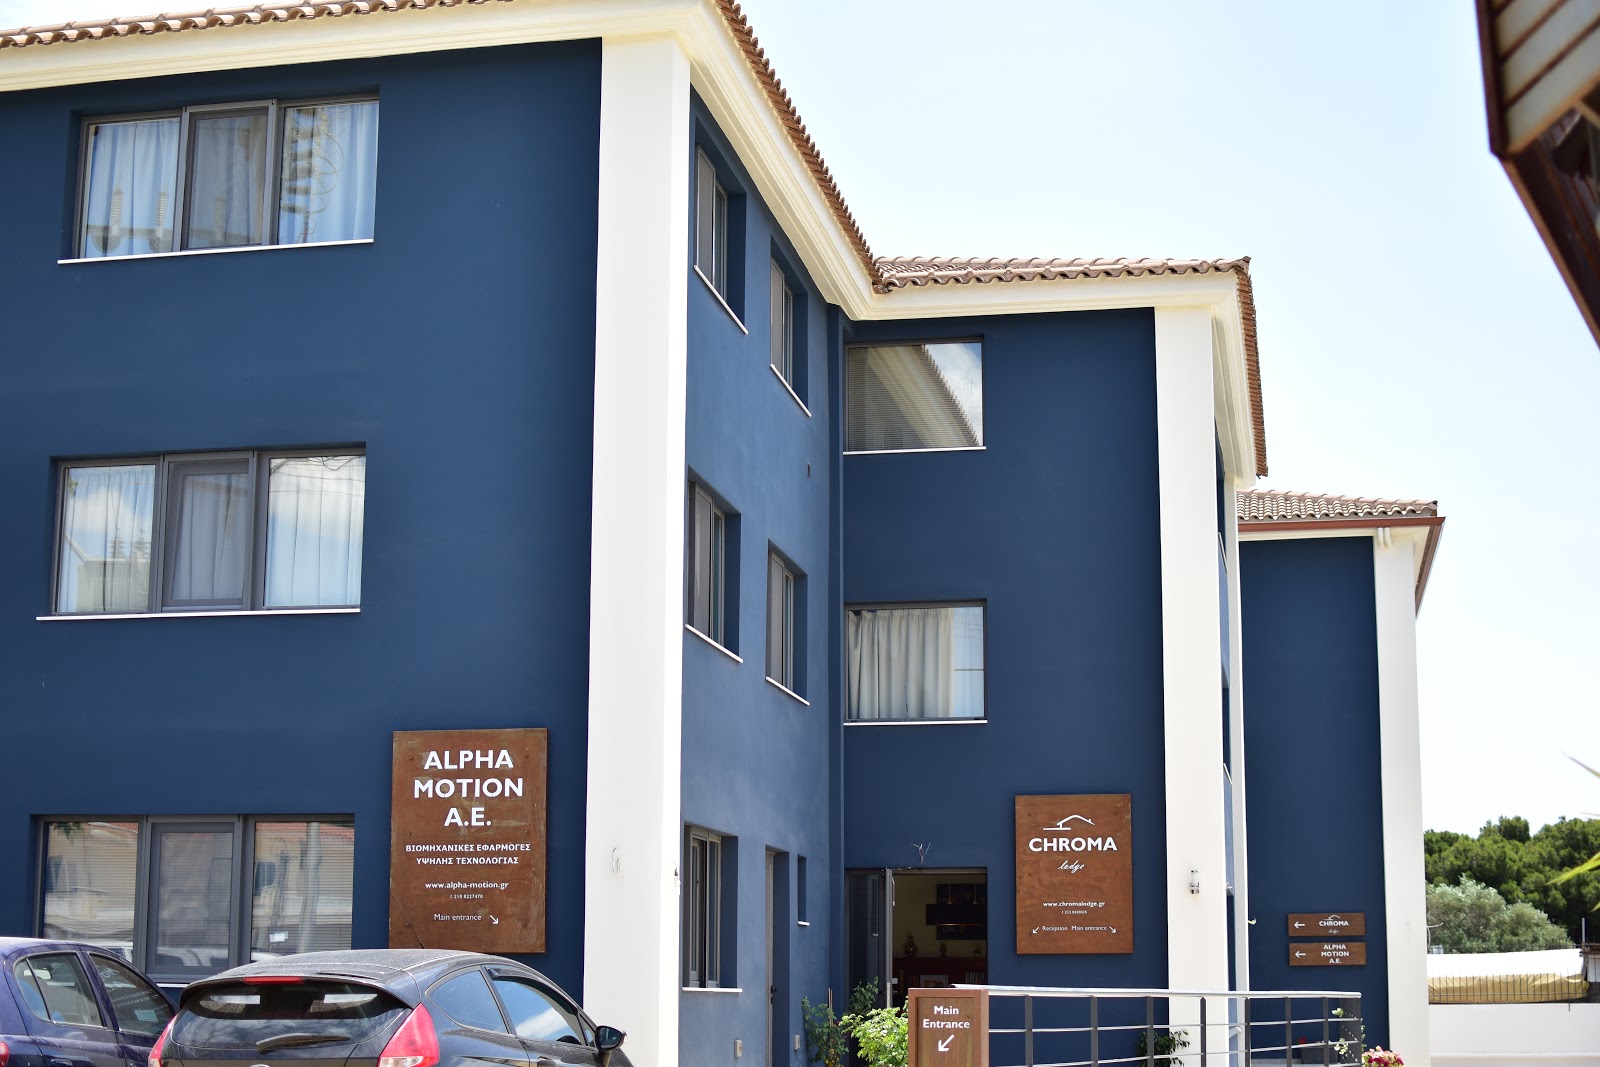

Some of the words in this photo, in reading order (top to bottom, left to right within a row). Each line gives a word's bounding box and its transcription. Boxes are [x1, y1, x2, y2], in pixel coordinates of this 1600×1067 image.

[423, 749, 515, 770] ALPHA
[413, 777, 524, 799] MOTION
[443, 807, 492, 827] A.E.
[405, 844, 475, 852] ΒΙΟΜΗΧΑΝΙΚΕΣ
[476, 843, 531, 852] ΕΦΑΡΜΟΓΕΣ
[1028, 836, 1118, 852] CHROMA
[416, 857, 454, 865] ΥΨΗΛΗΣ
[456, 856, 519, 865] ΤΕΧΝΟΛΟΓΙΑΣ
[1057, 859, 1085, 874] lodge
[424, 881, 509, 891] www.alpha-motion.gr
[433, 913, 451, 921] Main
[933, 1005, 960, 1015] Main
[922, 1018, 971, 1029] Entrance
